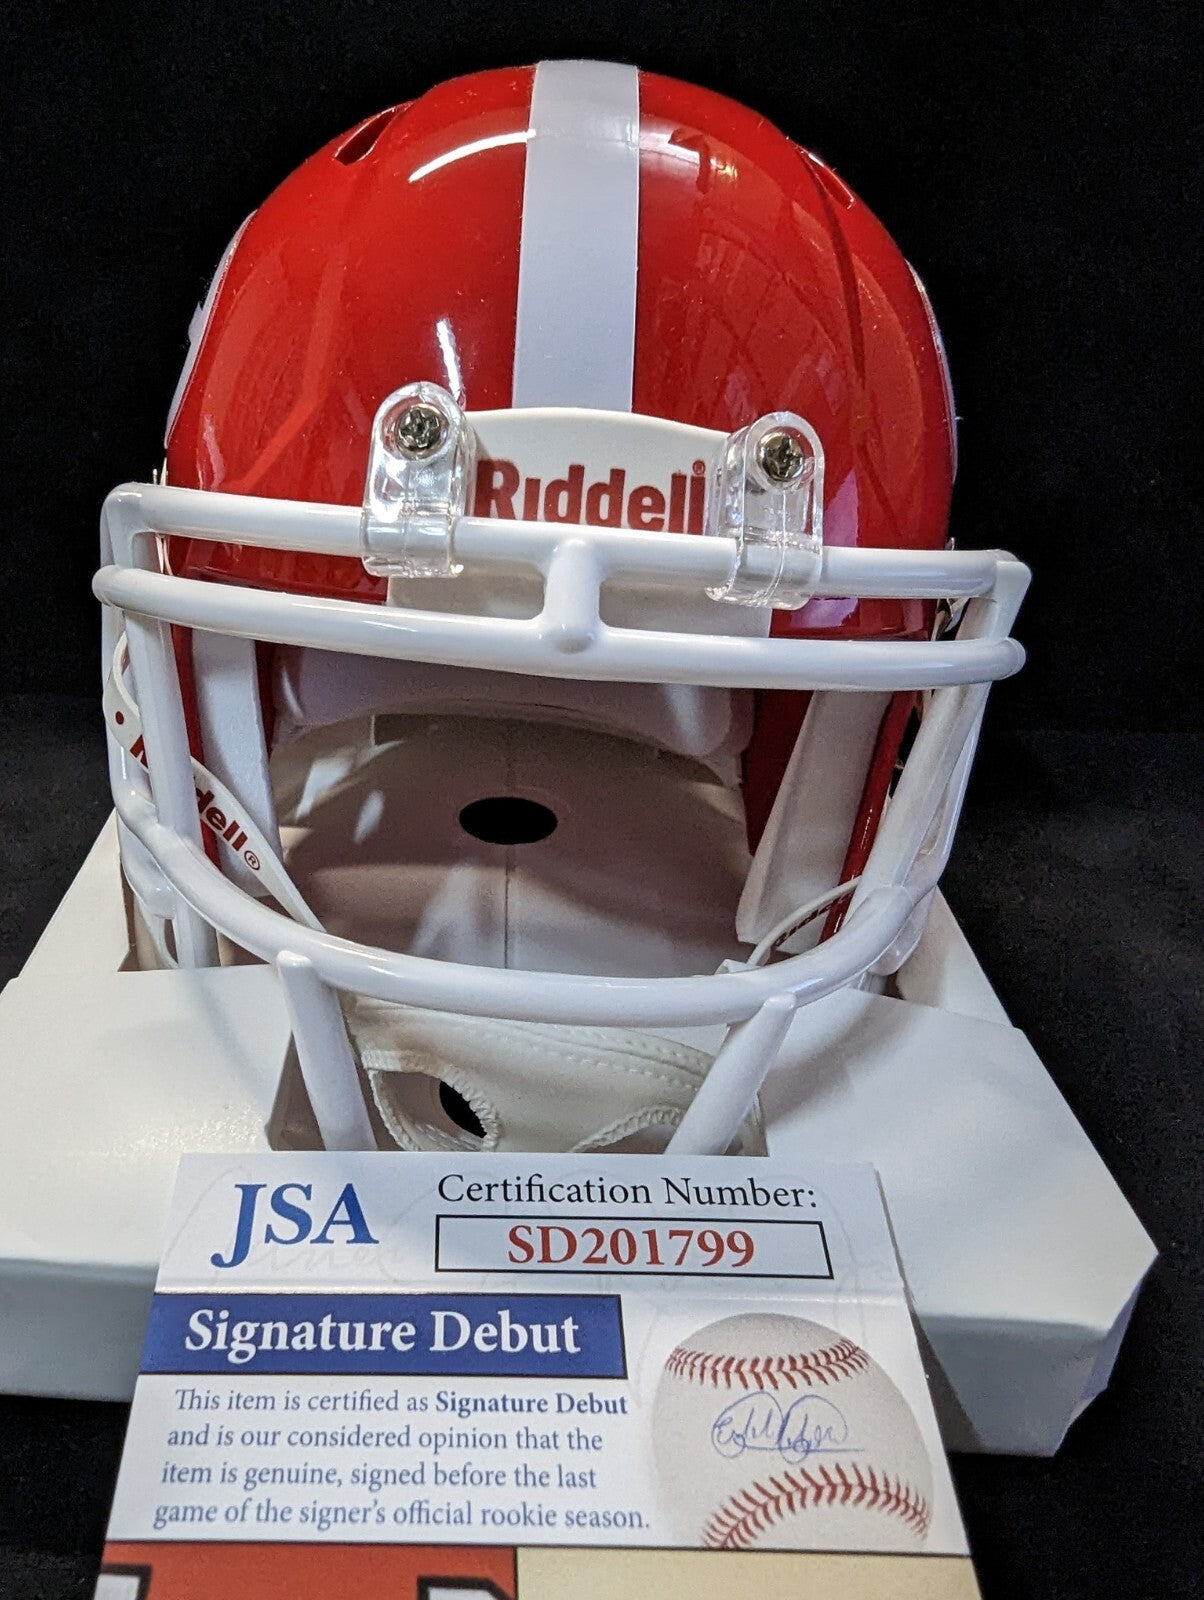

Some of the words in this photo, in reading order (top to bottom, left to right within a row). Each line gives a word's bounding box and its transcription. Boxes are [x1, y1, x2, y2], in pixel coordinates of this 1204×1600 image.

[437, 1173, 653, 1204] Certification
[660, 1177, 817, 1208] Number:
[210, 1182, 380, 1269] JSA
[507, 1224, 755, 1268] SD201799
[185, 1309, 416, 1364] Signature
[429, 1309, 581, 1354] Debut
[175, 1387, 220, 1411] This
[227, 1389, 276, 1411] item
[283, 1389, 301, 1411] is
[307, 1388, 399, 1412] certified
[406, 1396, 429, 1413] as
[435, 1390, 549, 1419] Signature
[555, 1391, 628, 1415] Debut
[167, 1423, 210, 1447] and
[216, 1424, 234, 1447] is
[240, 1430, 282, 1447] our
[286, 1423, 411, 1448] considered
[418, 1426, 508, 1456] opinion
[515, 1426, 560, 1450] that
[566, 1426, 603, 1451] the
[161, 1461, 212, 1484] item
[219, 1461, 238, 1484] is
[243, 1461, 343, 1492] genuine,
[350, 1461, 426, 1493] signed
[434, 1461, 507, 1487] before
[513, 1463, 550, 1488] the
[557, 1463, 597, 1489] last
[152, 1505, 218, 1531] game
[224, 1496, 255, 1523] of
[255, 1497, 293, 1523] the
[392, 1499, 472, 1526] official
[481, 1501, 557, 1528] rookie
[564, 1510, 650, 1529] season.
